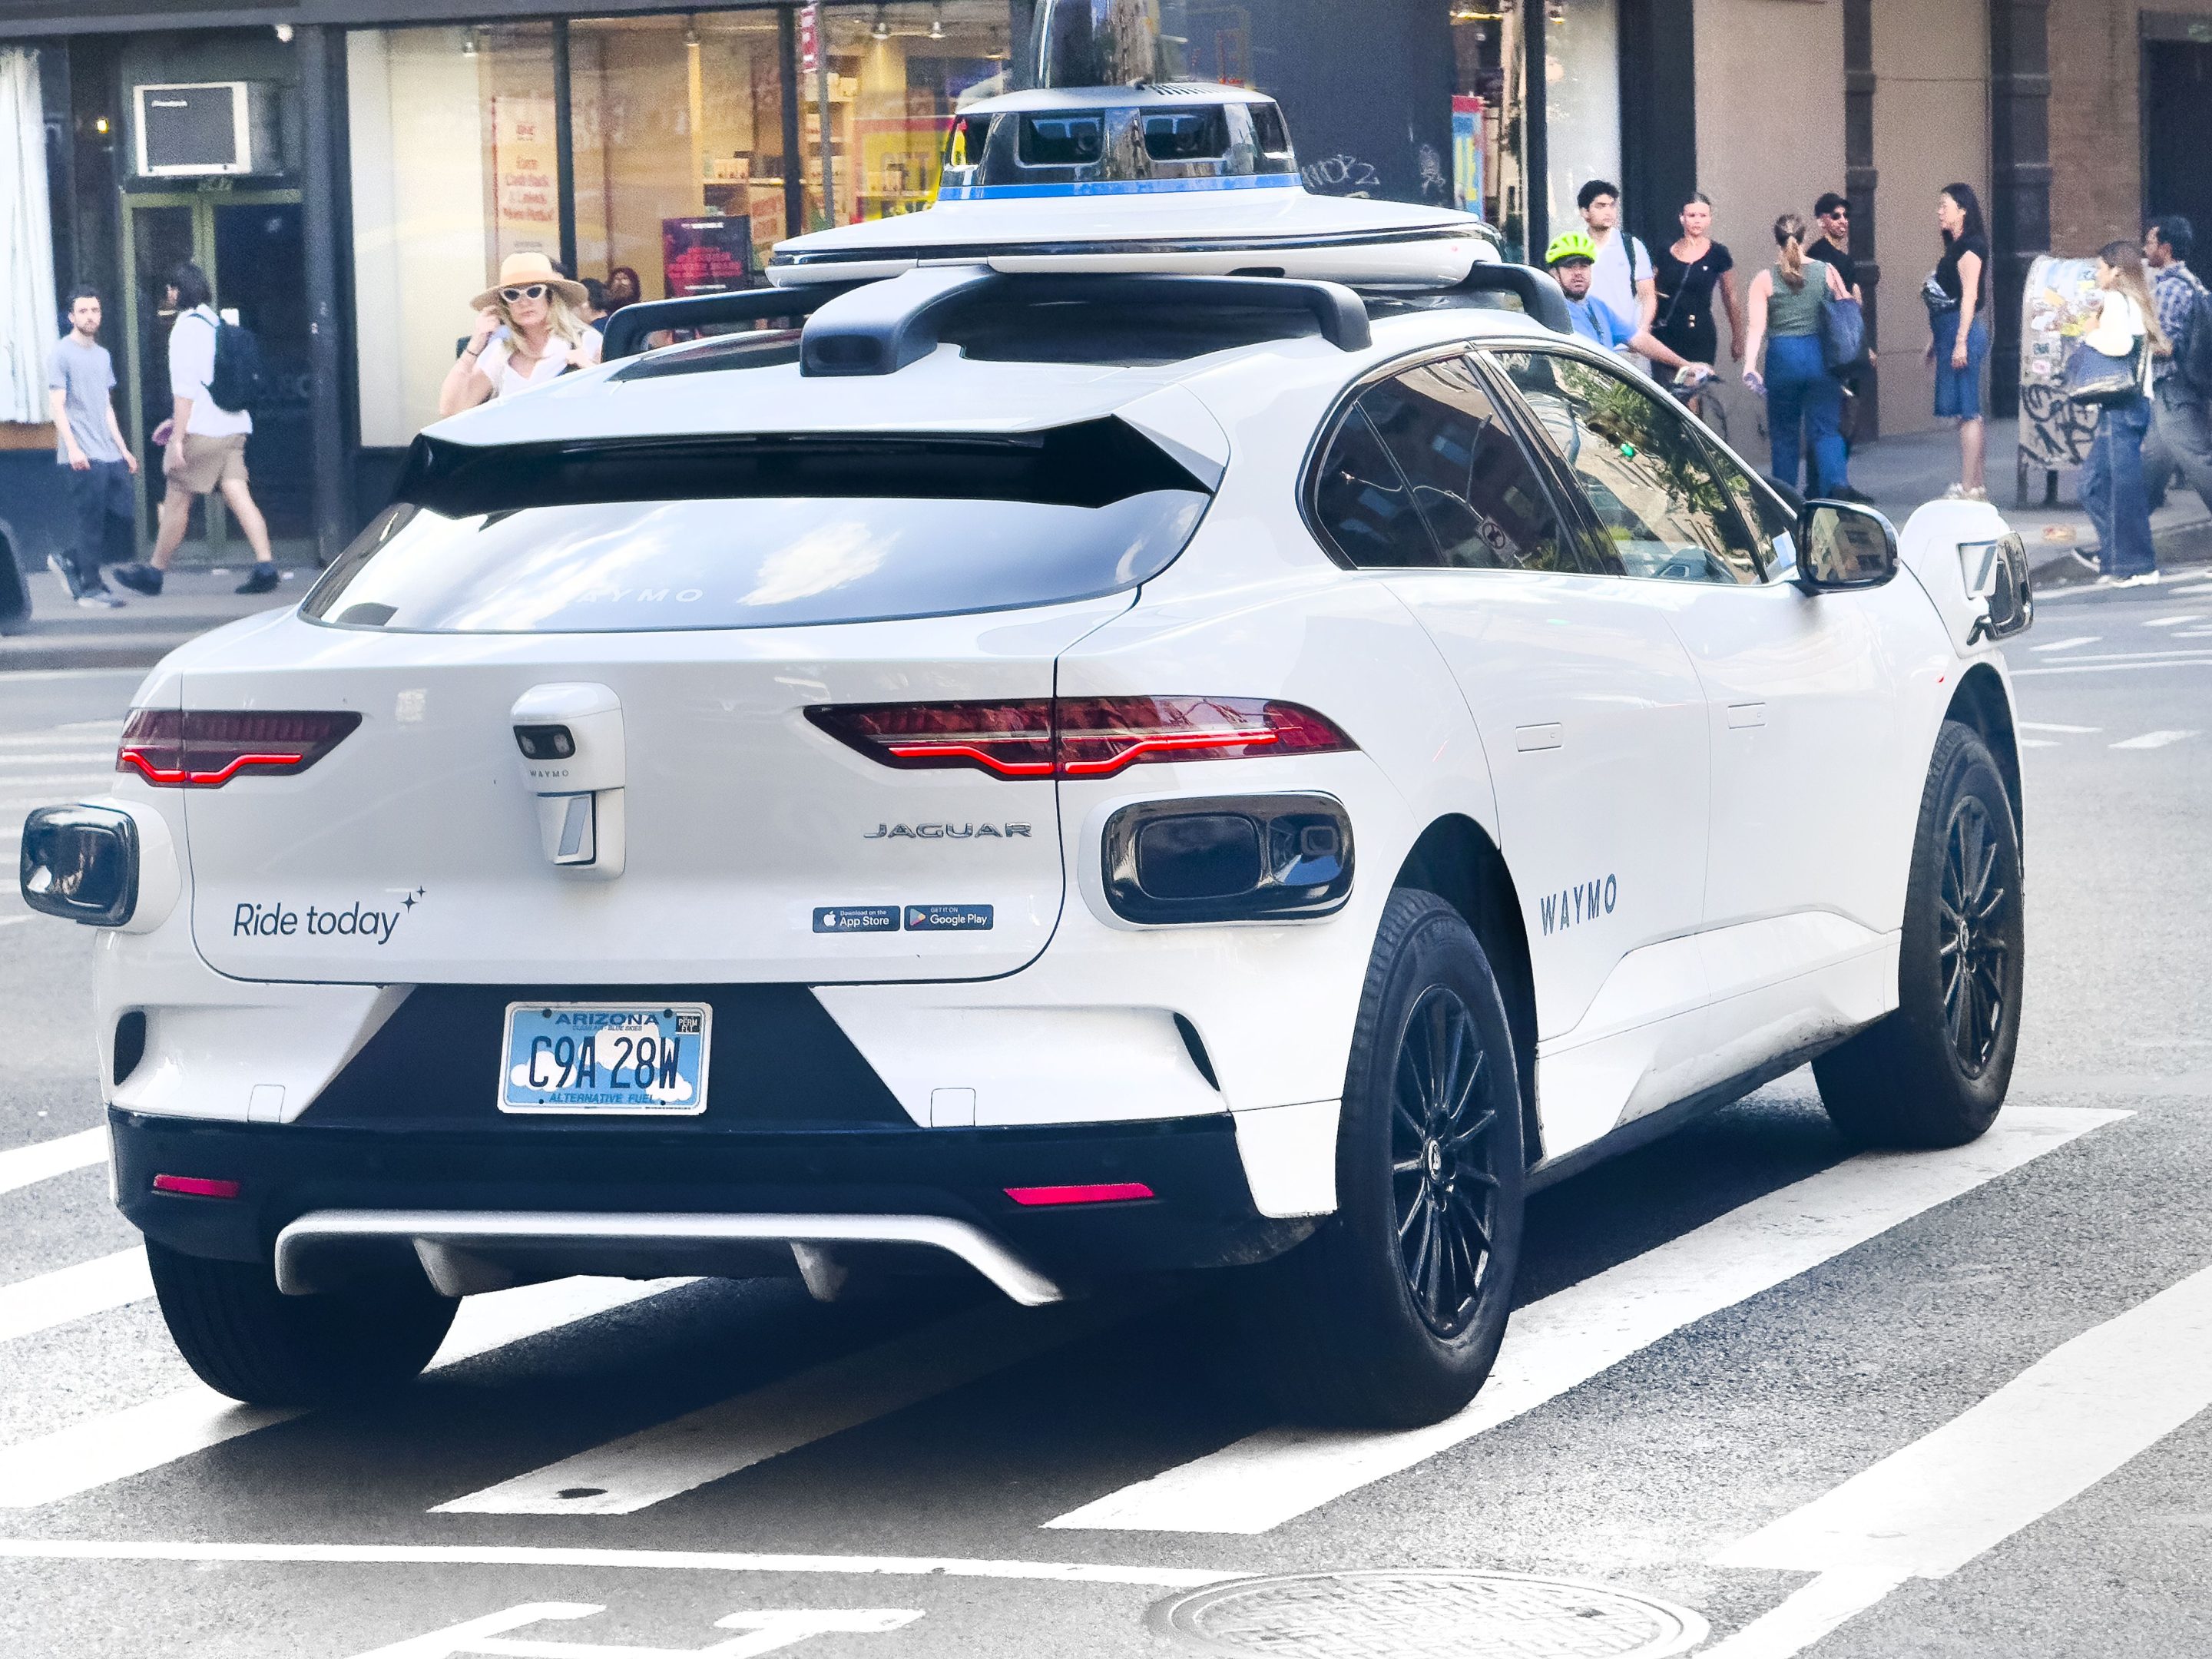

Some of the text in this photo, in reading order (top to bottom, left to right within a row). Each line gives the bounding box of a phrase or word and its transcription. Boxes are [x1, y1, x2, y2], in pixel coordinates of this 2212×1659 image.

[529, 769, 569, 777] WAYMO
[863, 821, 1032, 839] JAGUAR
[1540, 873, 1617, 936] WAYMO
[233, 900, 400, 945] Ride today
[839, 916, 889, 928] App Store
[930, 913, 988, 926] Google Play
[555, 1013, 661, 1025] ARIZONA
[528, 1035, 681, 1089] C9A 28W
[548, 1092, 656, 1104] ALTERNATIVE FUEL
